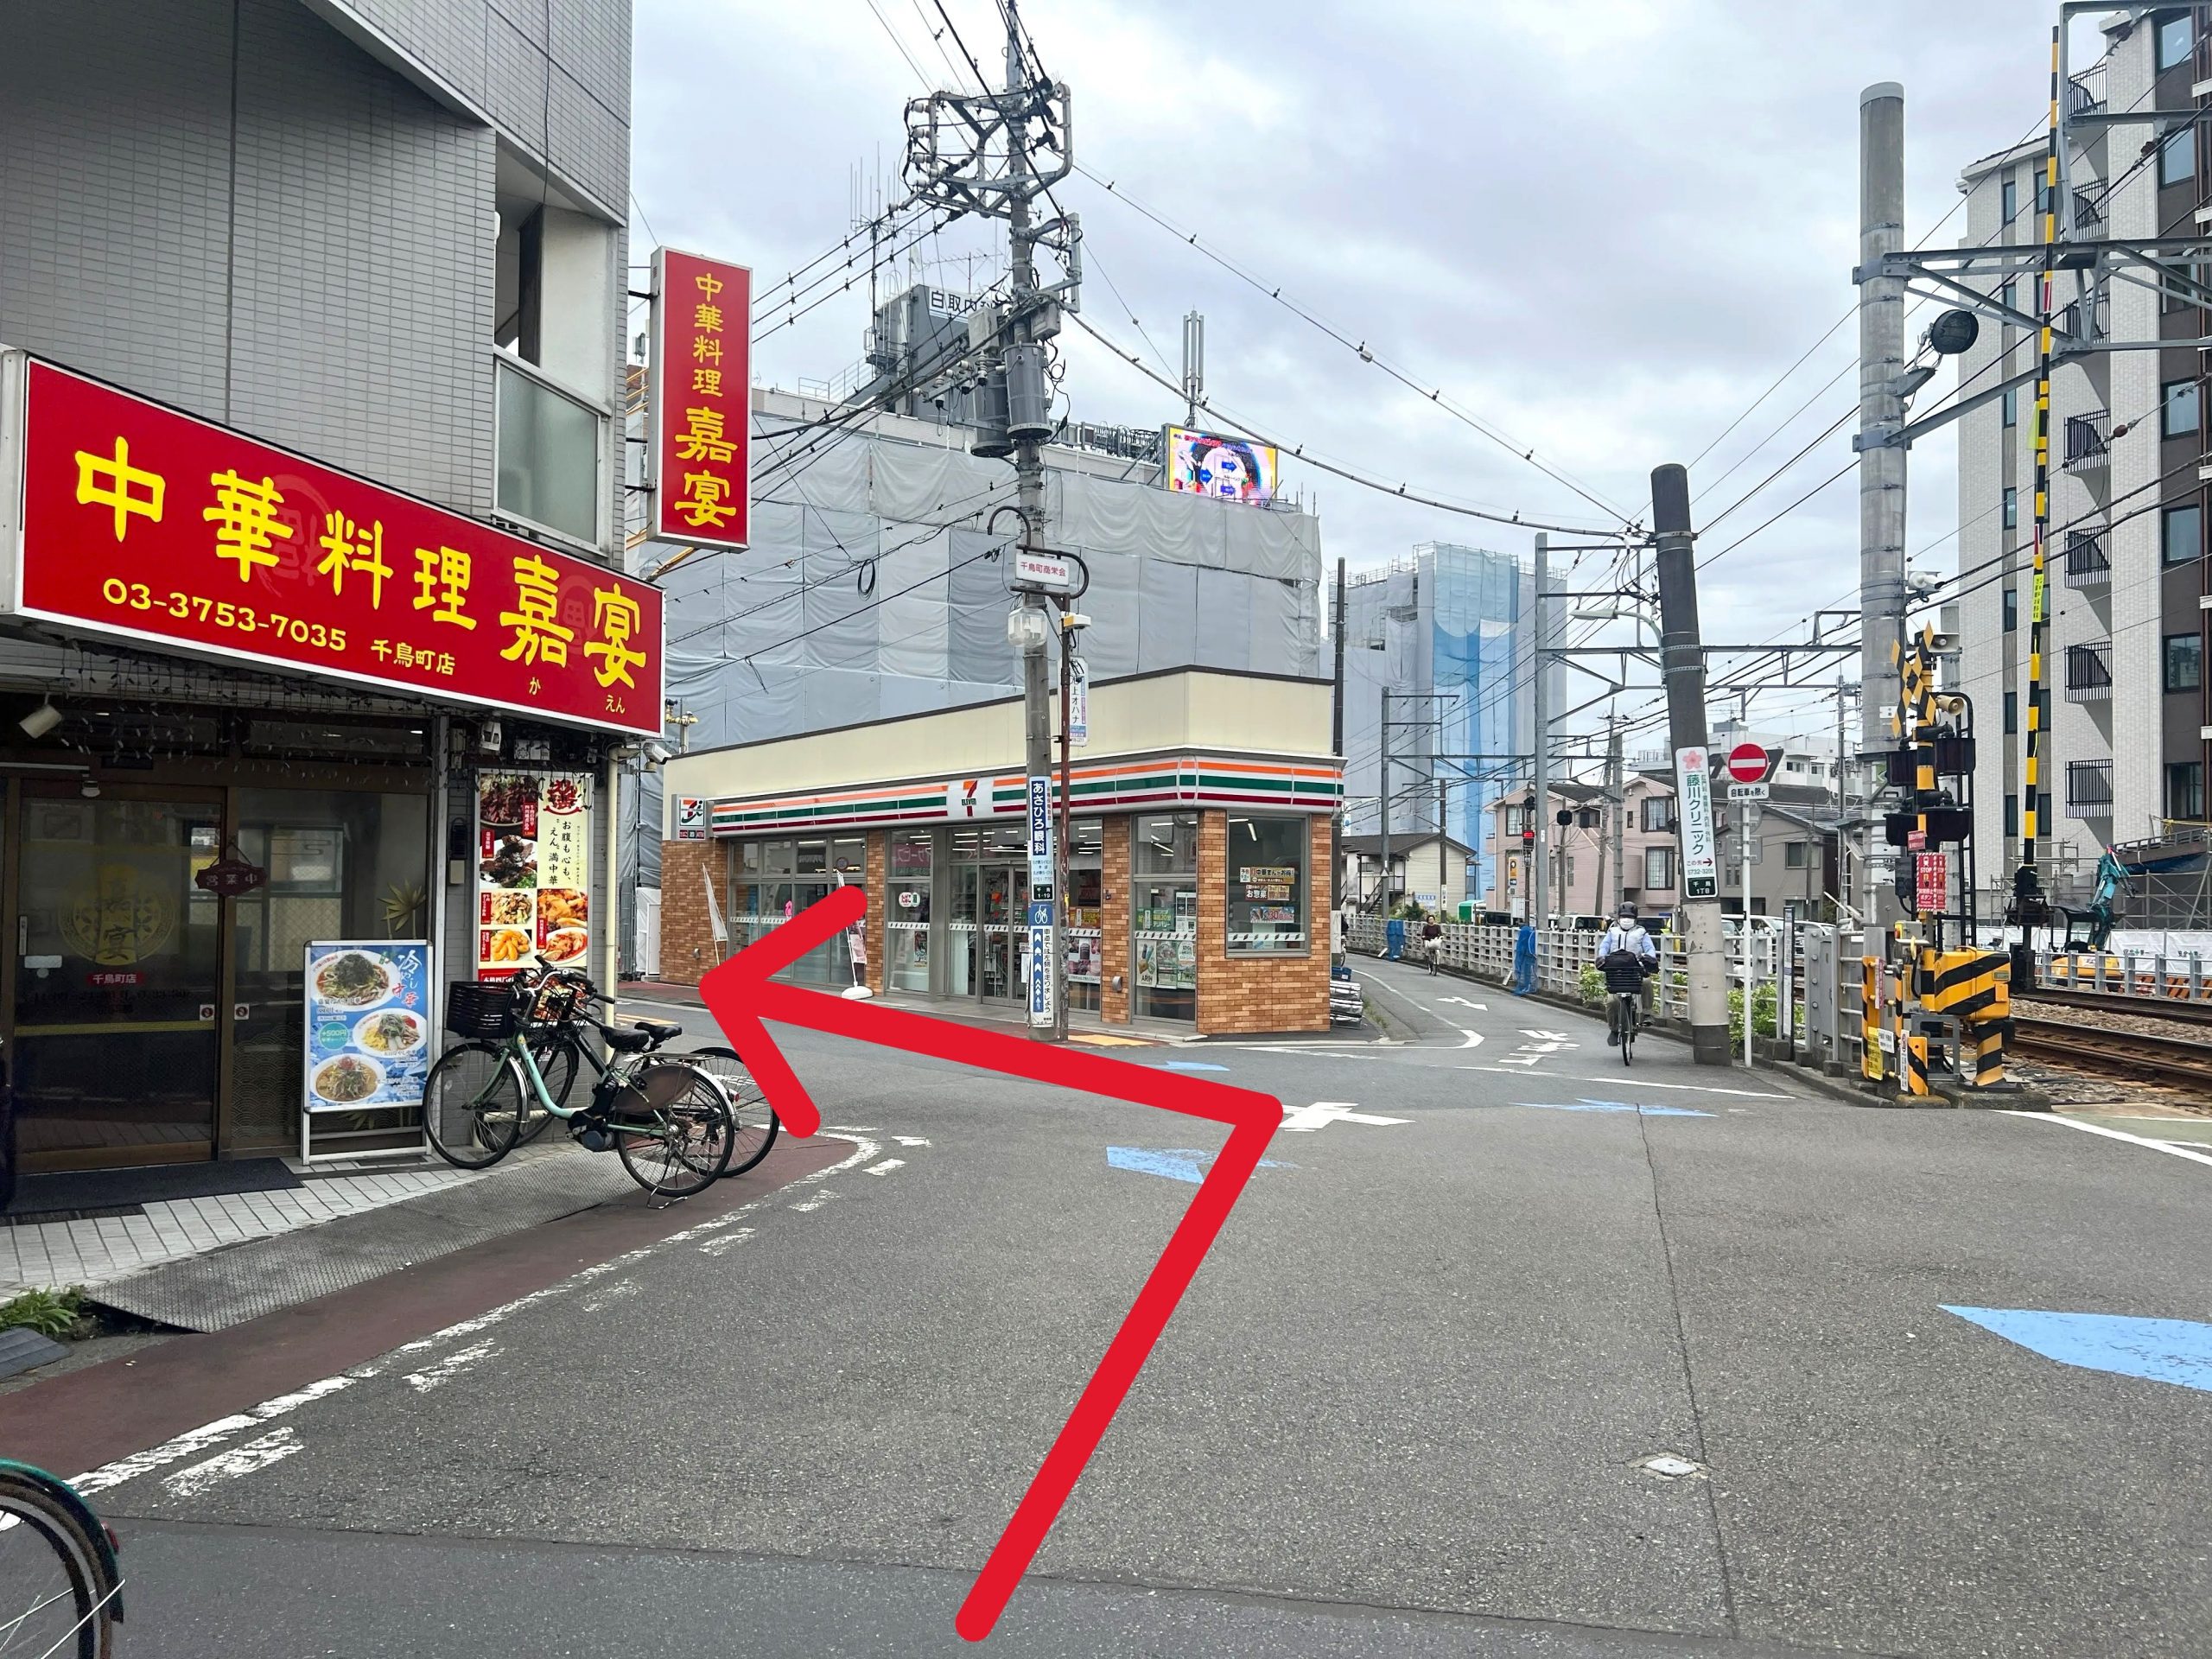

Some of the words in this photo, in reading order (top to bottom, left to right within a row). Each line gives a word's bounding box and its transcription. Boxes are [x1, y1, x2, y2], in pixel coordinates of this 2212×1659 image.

[692, 272, 724, 398] 中華料理
[674, 406, 739, 528] 嘉宴
[74, 435, 647, 690] 中華料理嘉宴
[1020, 562, 1066, 577] 千鳥町商栄会
[102, 577, 347, 652] 03-3753-7035
[370, 639, 456, 676] 千鳥町店
[528, 676, 542, 696] か
[605, 694, 626, 715] えん
[1033, 782, 1046, 854] あさひろ眼科
[1686, 773, 1704, 855] 藤川クリニック
[1731, 787, 1765, 798] 自転車を除く
[92, 973, 137, 984] 千鳥町店
